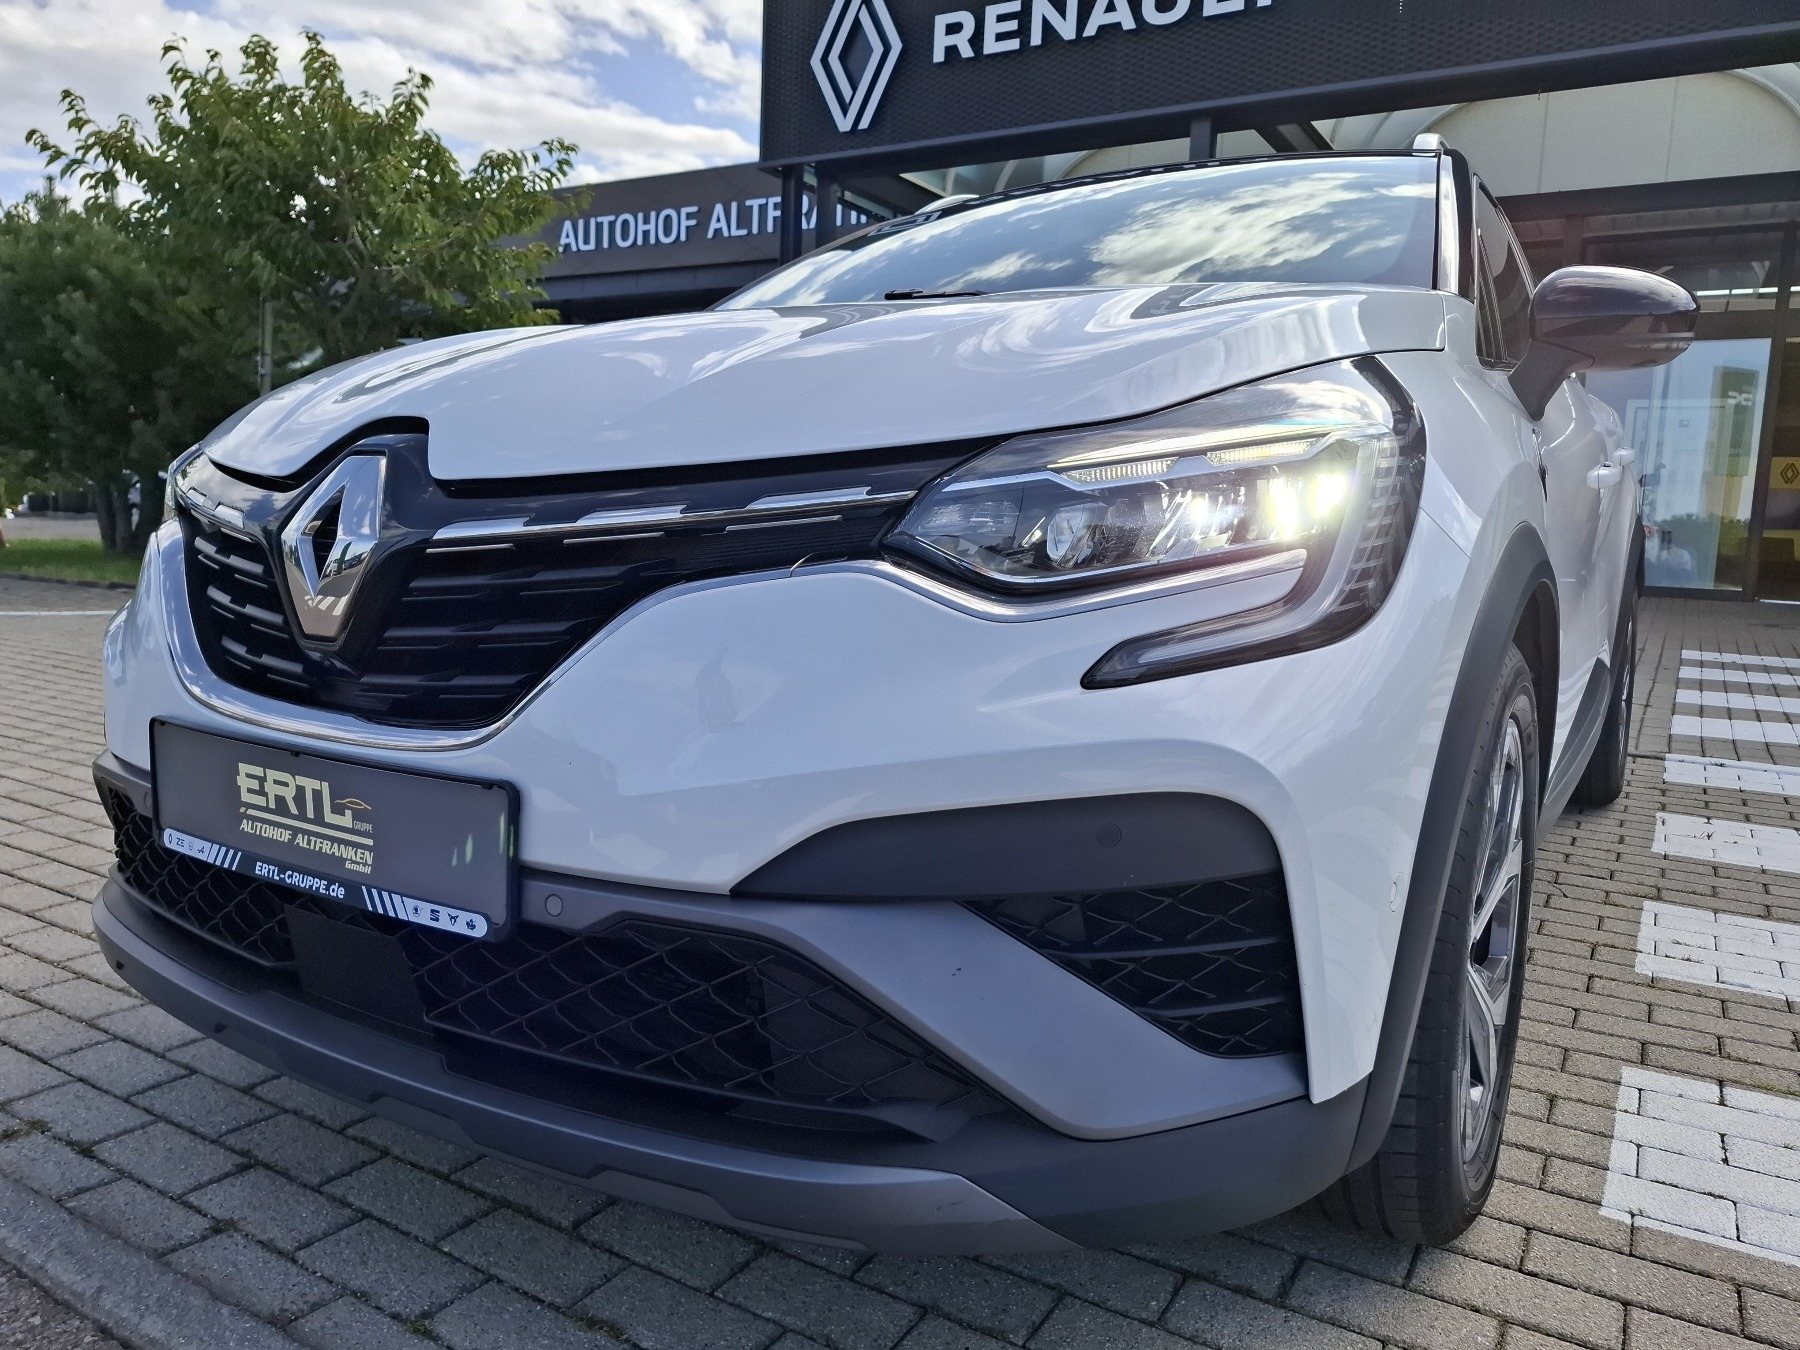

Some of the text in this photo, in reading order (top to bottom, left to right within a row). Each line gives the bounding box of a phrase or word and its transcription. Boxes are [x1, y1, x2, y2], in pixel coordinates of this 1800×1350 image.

[932, 0, 1272, 63] RENAU
[559, 205, 699, 253] AUTOHOF
[236, 762, 353, 828] ERTL
[239, 818, 374, 865] AUTOHOF ALTFRANKEN
[353, 820, 374, 834] GRUPPE
[254, 861, 346, 899] ERTL-GRUPPE.de
[345, 860, 372, 874] GmbH
